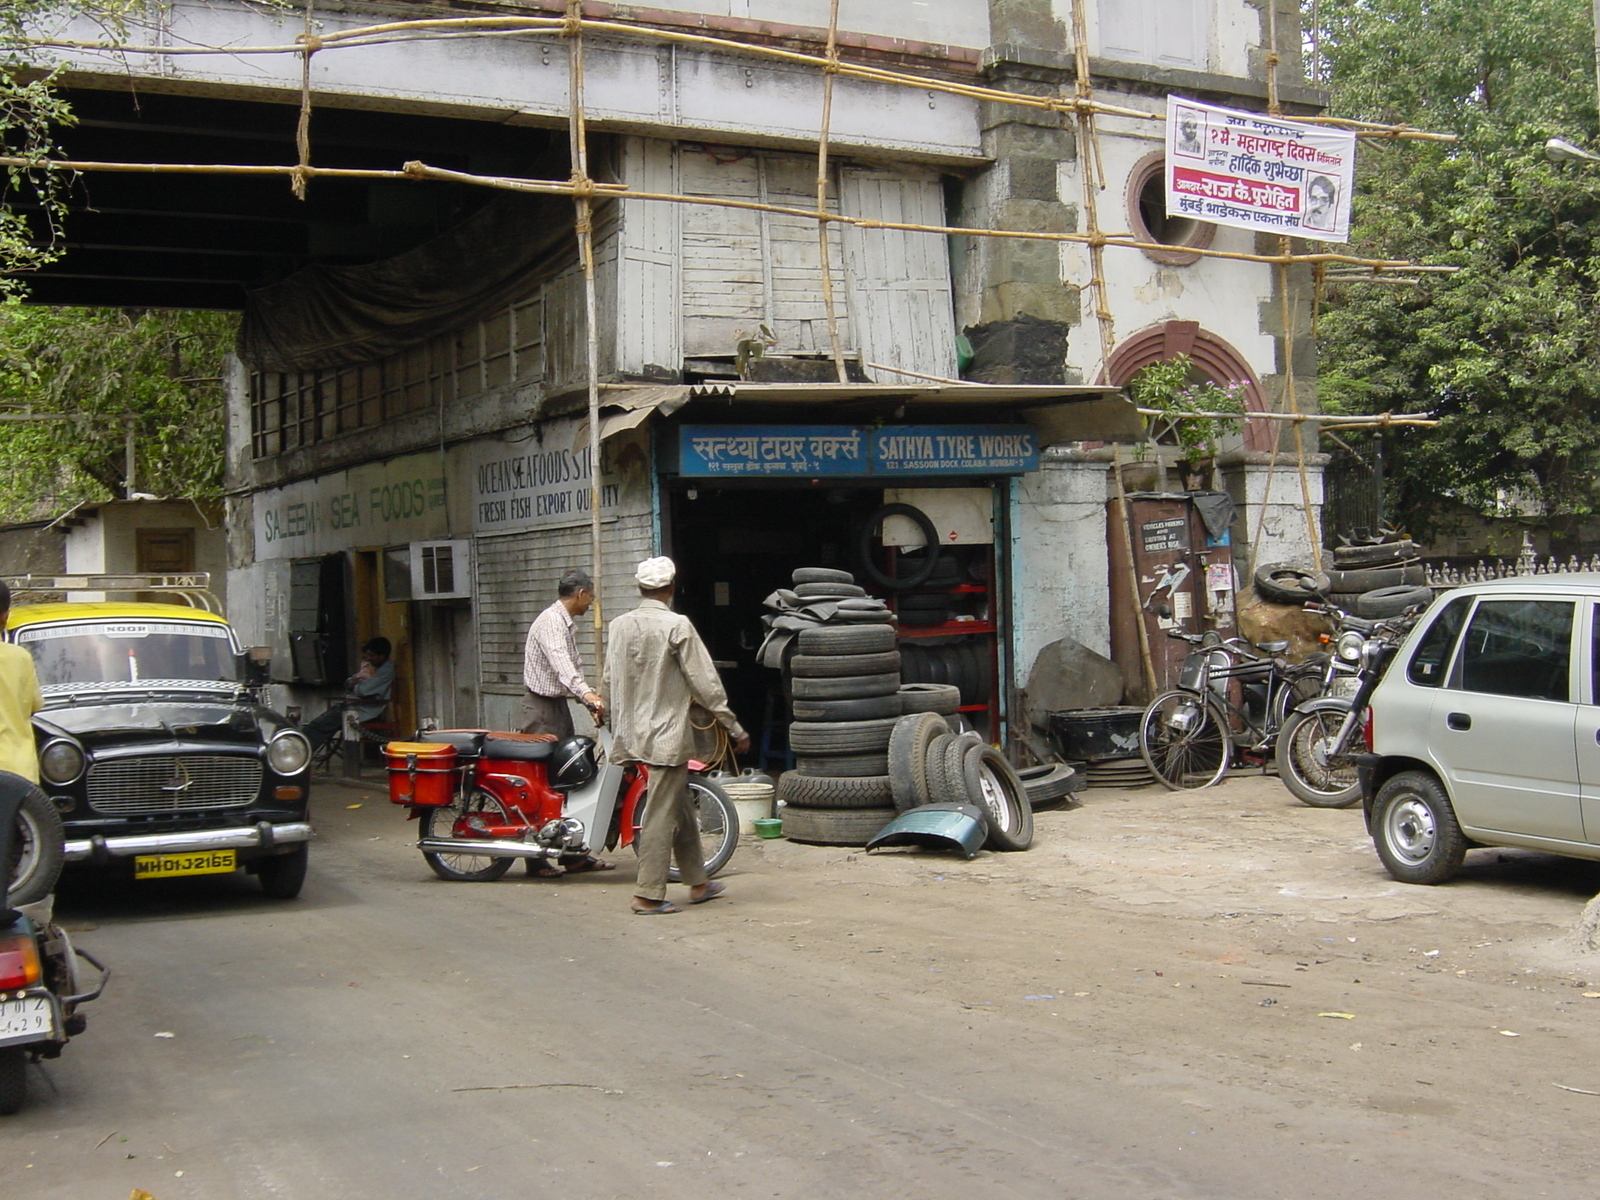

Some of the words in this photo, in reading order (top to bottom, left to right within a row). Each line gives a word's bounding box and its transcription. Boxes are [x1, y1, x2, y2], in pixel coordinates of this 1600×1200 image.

[1236, 132, 1286, 158] महाराष्ट्र
[1286, 139, 1317, 162] दिवस
[1229, 152, 1262, 175] हार्दिक
[1263, 161, 1305, 183] शुभेच्छा
[1201, 177, 1235, 199] राज
[1252, 186, 1296, 209] पुरोहित
[1179, 196, 1203, 214] मुंबई
[1253, 212, 1283, 226] एकता
[1284, 214, 1301, 228] संघ
[760, 436, 807, 461] टायर
[878, 435, 935, 460] SATHYA
[935, 435, 976, 459] TYRE
[978, 433, 1033, 459] WORKS
[903, 460, 940, 469] SASSOON
[330, 491, 361, 530] SEA
[369, 478, 425, 524] FOODS
[479, 500, 507, 523] FRESH
[510, 496, 532, 520] FISH
[536, 490, 573, 517] EXPORT
[576, 483, 620, 513] QUITY
